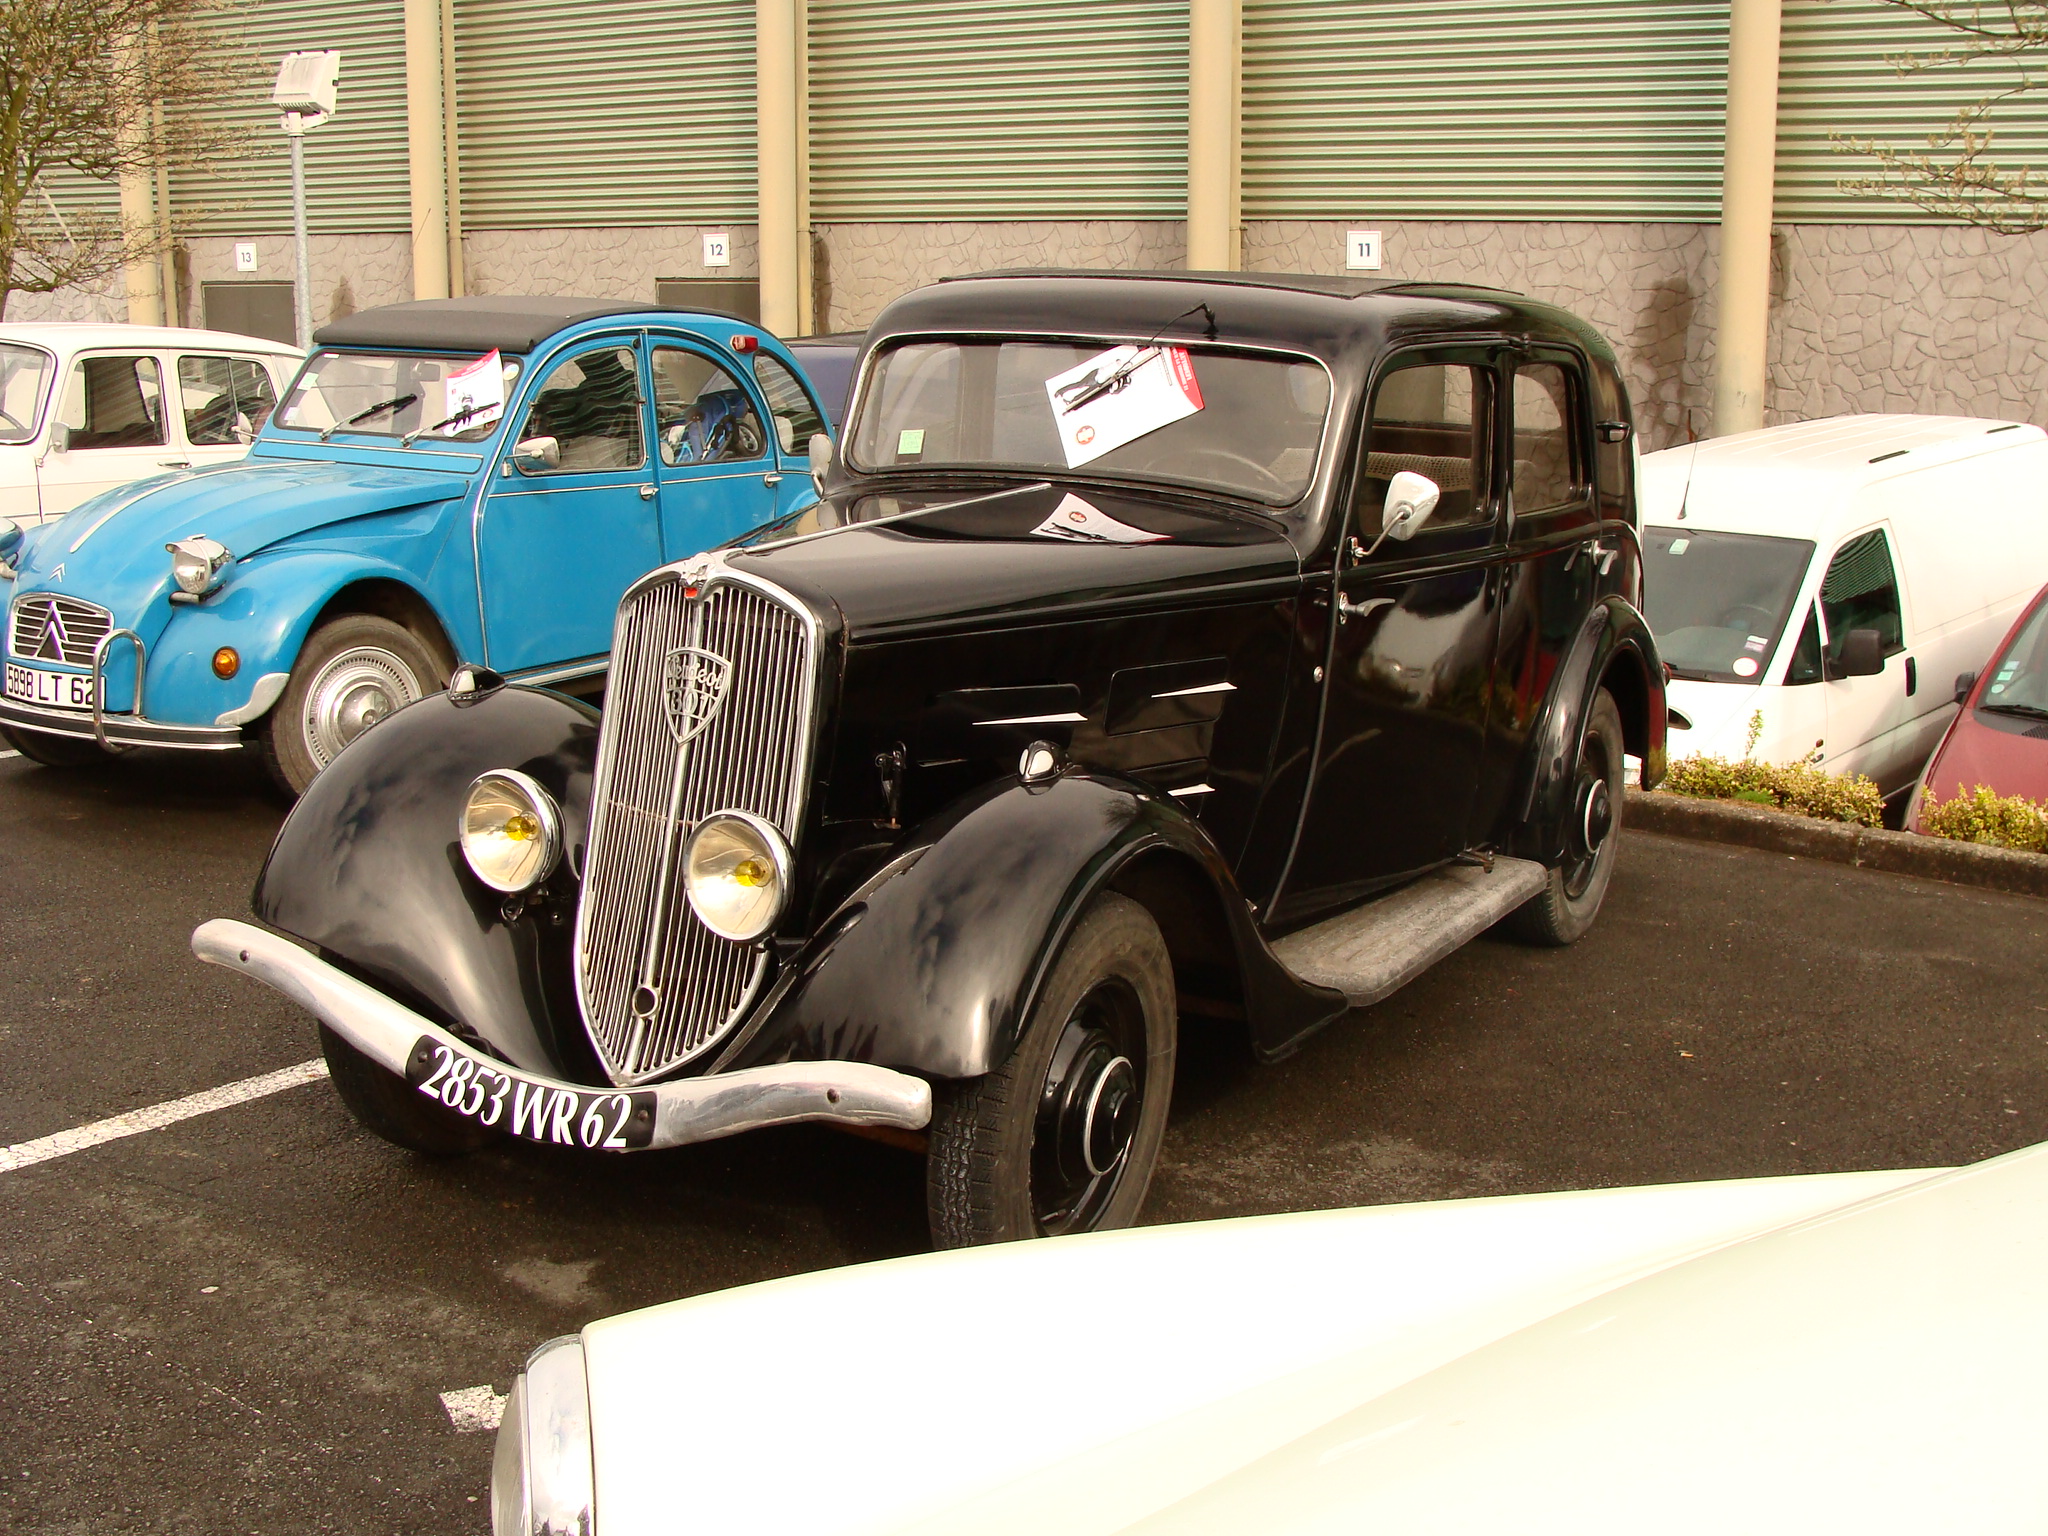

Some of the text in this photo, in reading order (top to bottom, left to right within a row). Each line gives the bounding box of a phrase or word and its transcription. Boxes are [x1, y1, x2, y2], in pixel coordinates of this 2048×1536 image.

[710, 243, 723, 256] 12
[1358, 242, 1370, 257] 11
[241, 252, 252, 263] 13
[8, 666, 95, 706] 5898 LT 62
[418, 1045, 633, 1148] 2853 WR 62
